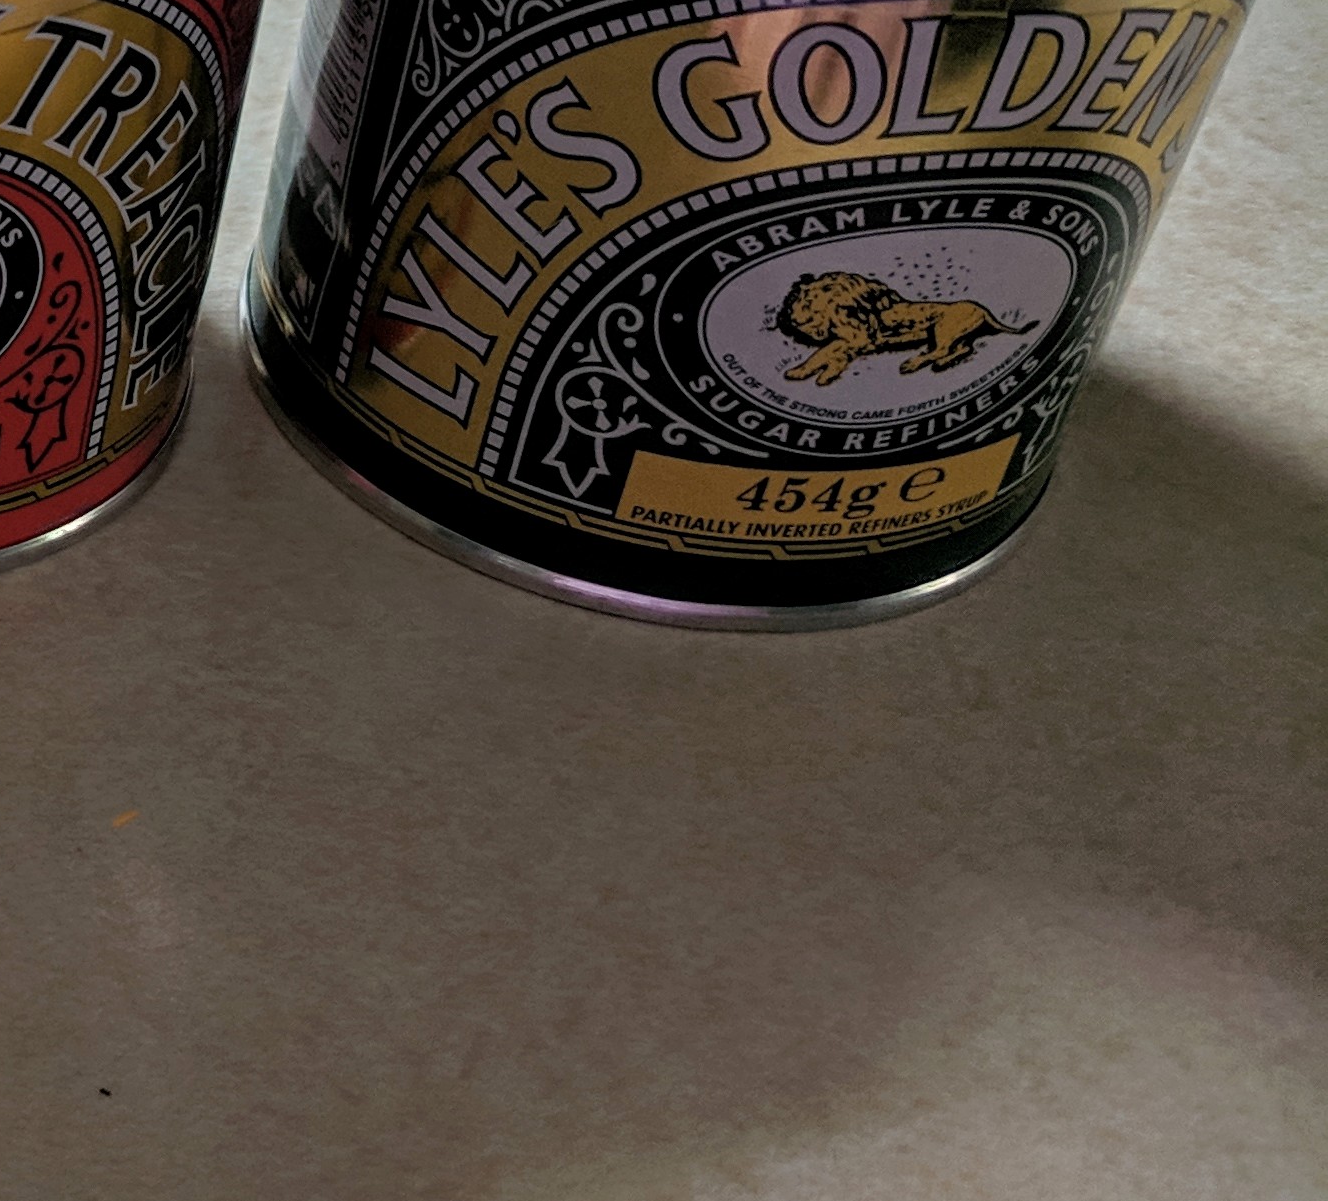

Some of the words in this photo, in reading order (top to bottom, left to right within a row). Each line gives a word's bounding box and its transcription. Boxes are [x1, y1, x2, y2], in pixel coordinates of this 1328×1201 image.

[6, 14, 207, 410] TREACLE
[366, 75, 643, 430] LYLE'S
[652, 7, 1229, 163] GOLDEN
[710, 206, 867, 273] ABRAM
[891, 197, 996, 224] LYLE
[1007, 198, 1031, 221] &
[1041, 203, 1099, 258] SONS
[688, 374, 822, 450] SUGAR
[843, 353, 1041, 451] REFINERS
[722, 352, 745, 378] OUT
[742, 375, 760, 390] OF
[762, 387, 788, 408] THE
[789, 400, 848, 421] STRONG
[851, 407, 895, 421] CAME
[897, 394, 946, 417] FORTH
[948, 342, 1030, 400] SWEETNESS
[630, 505, 741, 536] PARTIALLY
[745, 522, 843, 538] INVERTED
[848, 510, 932, 536] REFINERS
[935, 489, 989, 519] SYRUP
[736, 476, 888, 520] 454g
